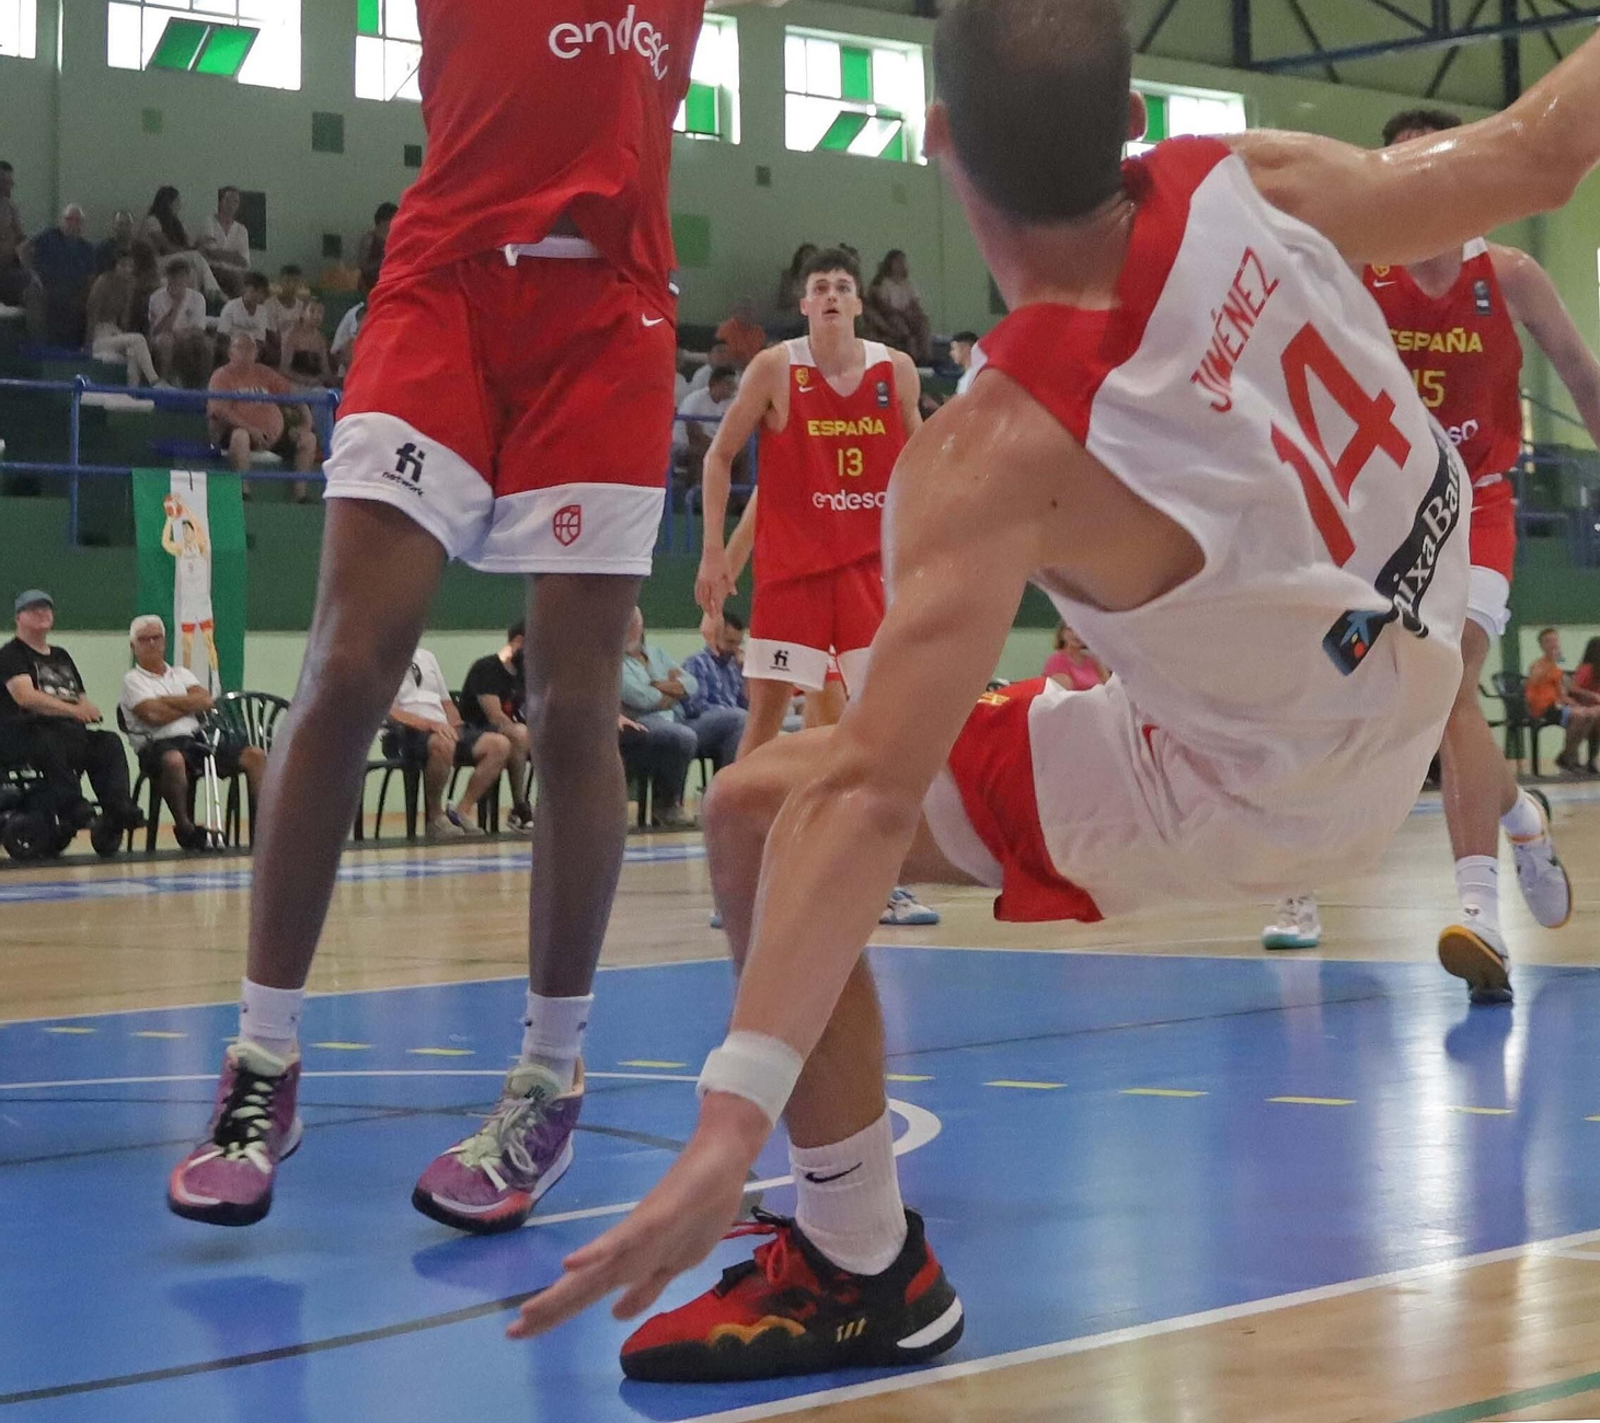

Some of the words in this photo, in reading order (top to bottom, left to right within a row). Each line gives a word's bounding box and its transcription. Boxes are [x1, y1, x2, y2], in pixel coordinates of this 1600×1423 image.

[1190, 246, 1280, 412] JIMÉNEZ
[807, 417, 886, 436] ESPAÑA
[837, 447, 864, 477] 13
[1270, 321, 1412, 568] 14
